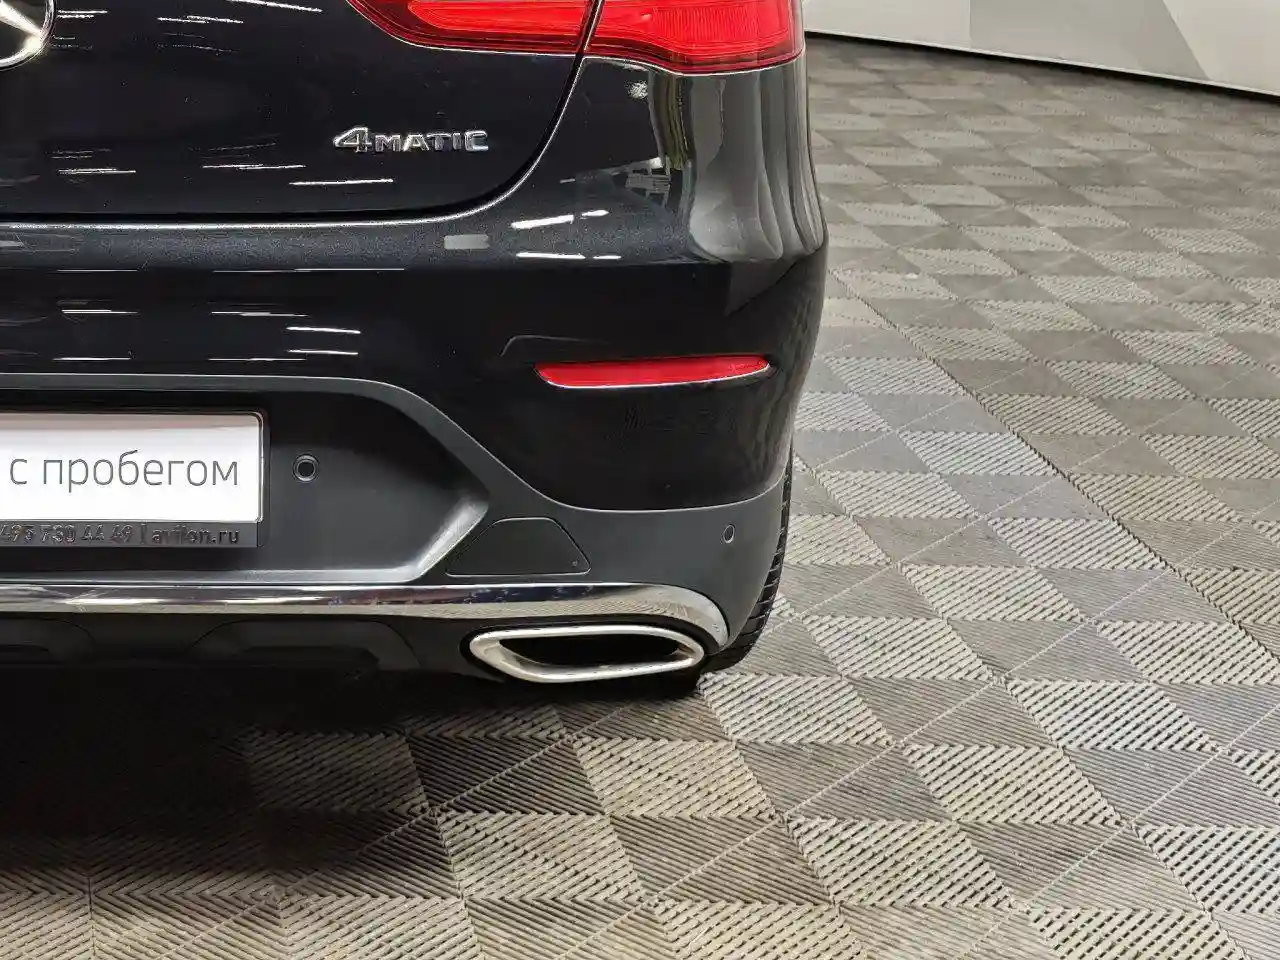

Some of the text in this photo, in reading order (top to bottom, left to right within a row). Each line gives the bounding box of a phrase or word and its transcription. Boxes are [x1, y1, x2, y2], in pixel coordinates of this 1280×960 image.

[333, 126, 489, 152] 4MATIC
[9, 458, 28, 485] с
[42, 449, 239, 493] пробегом
